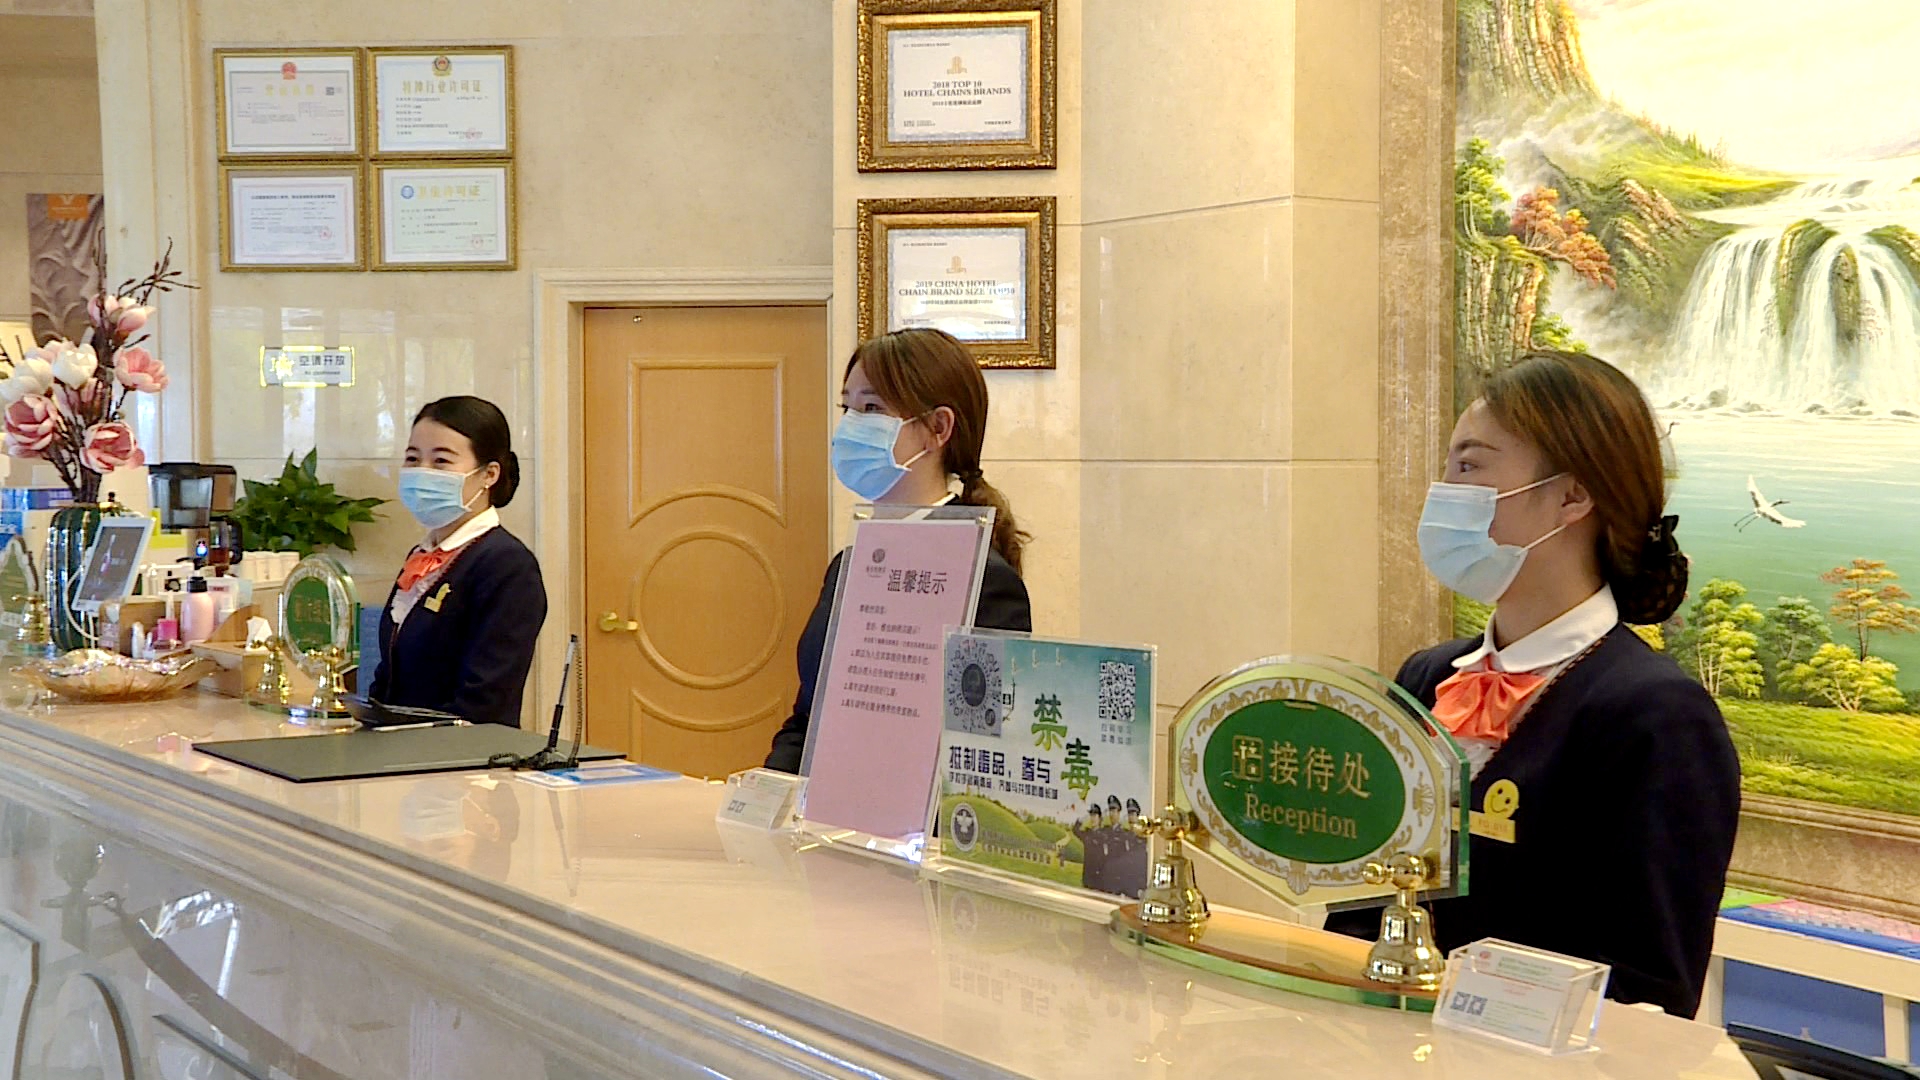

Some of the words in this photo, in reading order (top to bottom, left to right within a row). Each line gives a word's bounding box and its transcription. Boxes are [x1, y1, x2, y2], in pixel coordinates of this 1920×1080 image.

[952, 80, 971, 89] TOP
[903, 89, 934, 98] HOTEL
[936, 88, 971, 97] CHAINS
[973, 87, 1012, 96] BRANDS
[915, 280, 933, 288] 2019
[934, 280, 964, 288] CHINA
[966, 279, 996, 288] HOTEL
[898, 288, 929, 296] CHAIN
[930, 288, 963, 296] BRAND
[965, 287, 985, 296] SIZE
[299, 355, 345, 366] 空调开放
[887, 569, 948, 595] 温馨提示
[1268, 740, 1372, 799] 接待处
[1244, 791, 1358, 840] Reception
